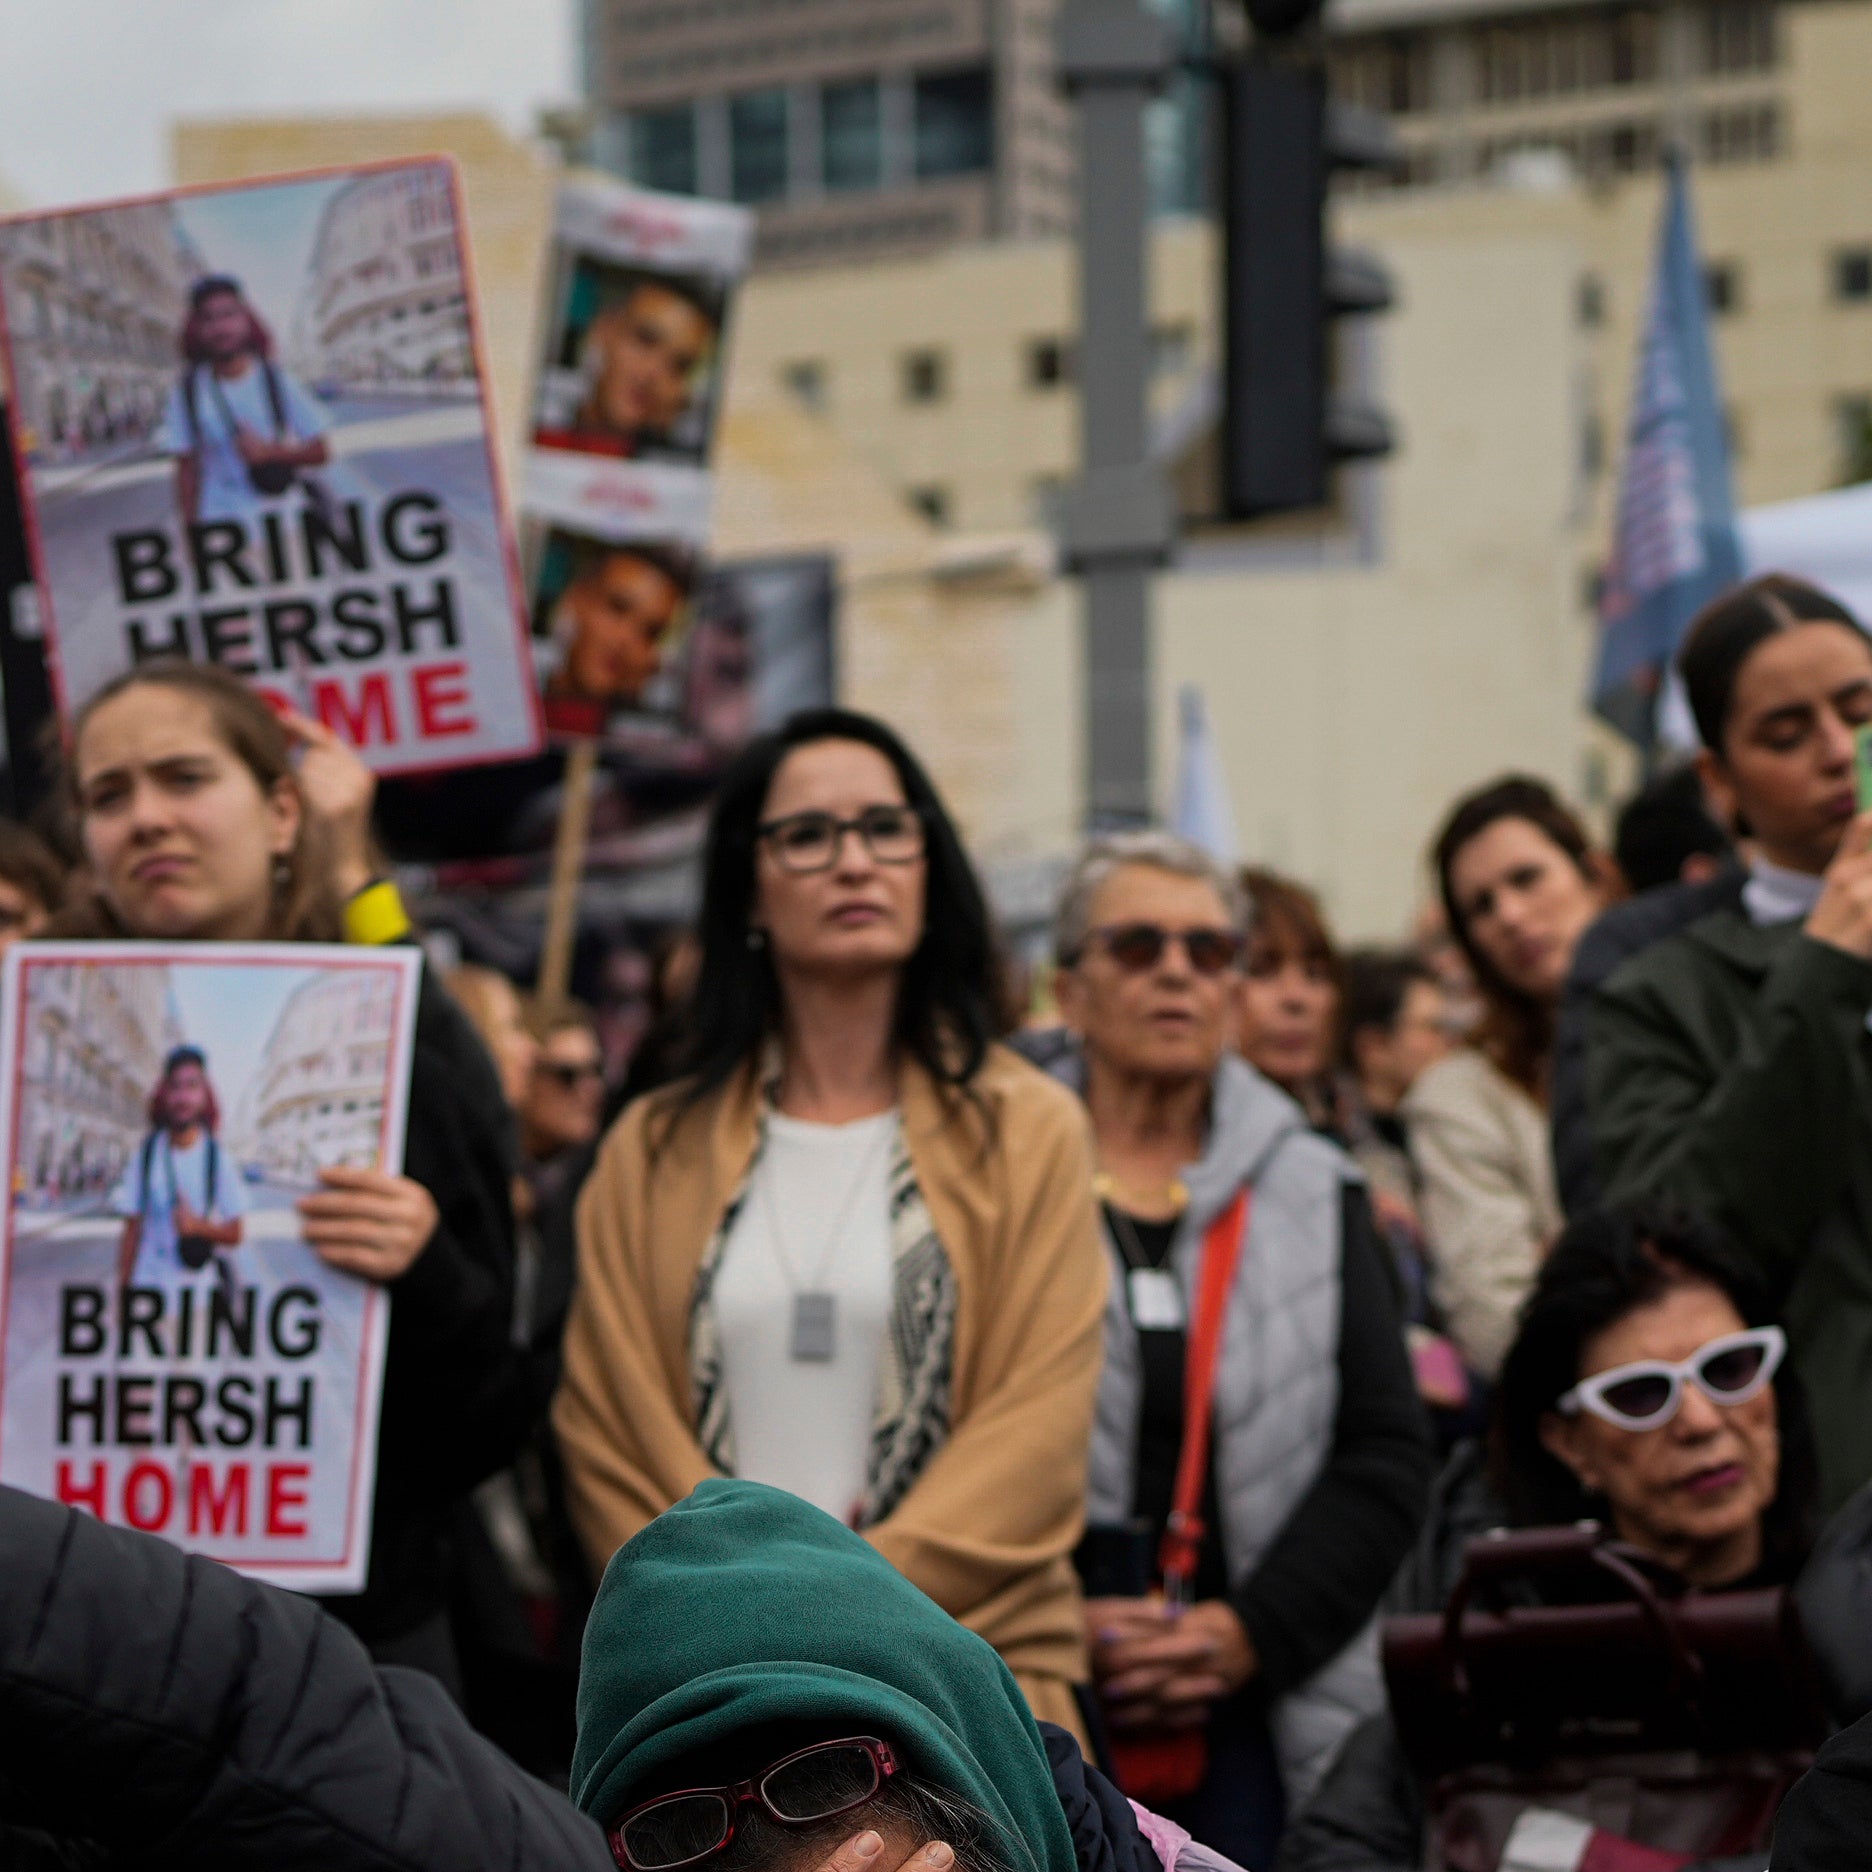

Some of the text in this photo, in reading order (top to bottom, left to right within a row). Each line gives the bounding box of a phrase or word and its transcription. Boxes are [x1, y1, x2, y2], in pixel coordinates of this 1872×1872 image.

[111, 489, 450, 605] BRING
[128, 580, 459, 675] HERSH
[258, 661, 478, 752] ME
[60, 1284, 323, 1360] BRING
[57, 1373, 315, 1448] HERSH
[57, 1459, 312, 1537] HOME
